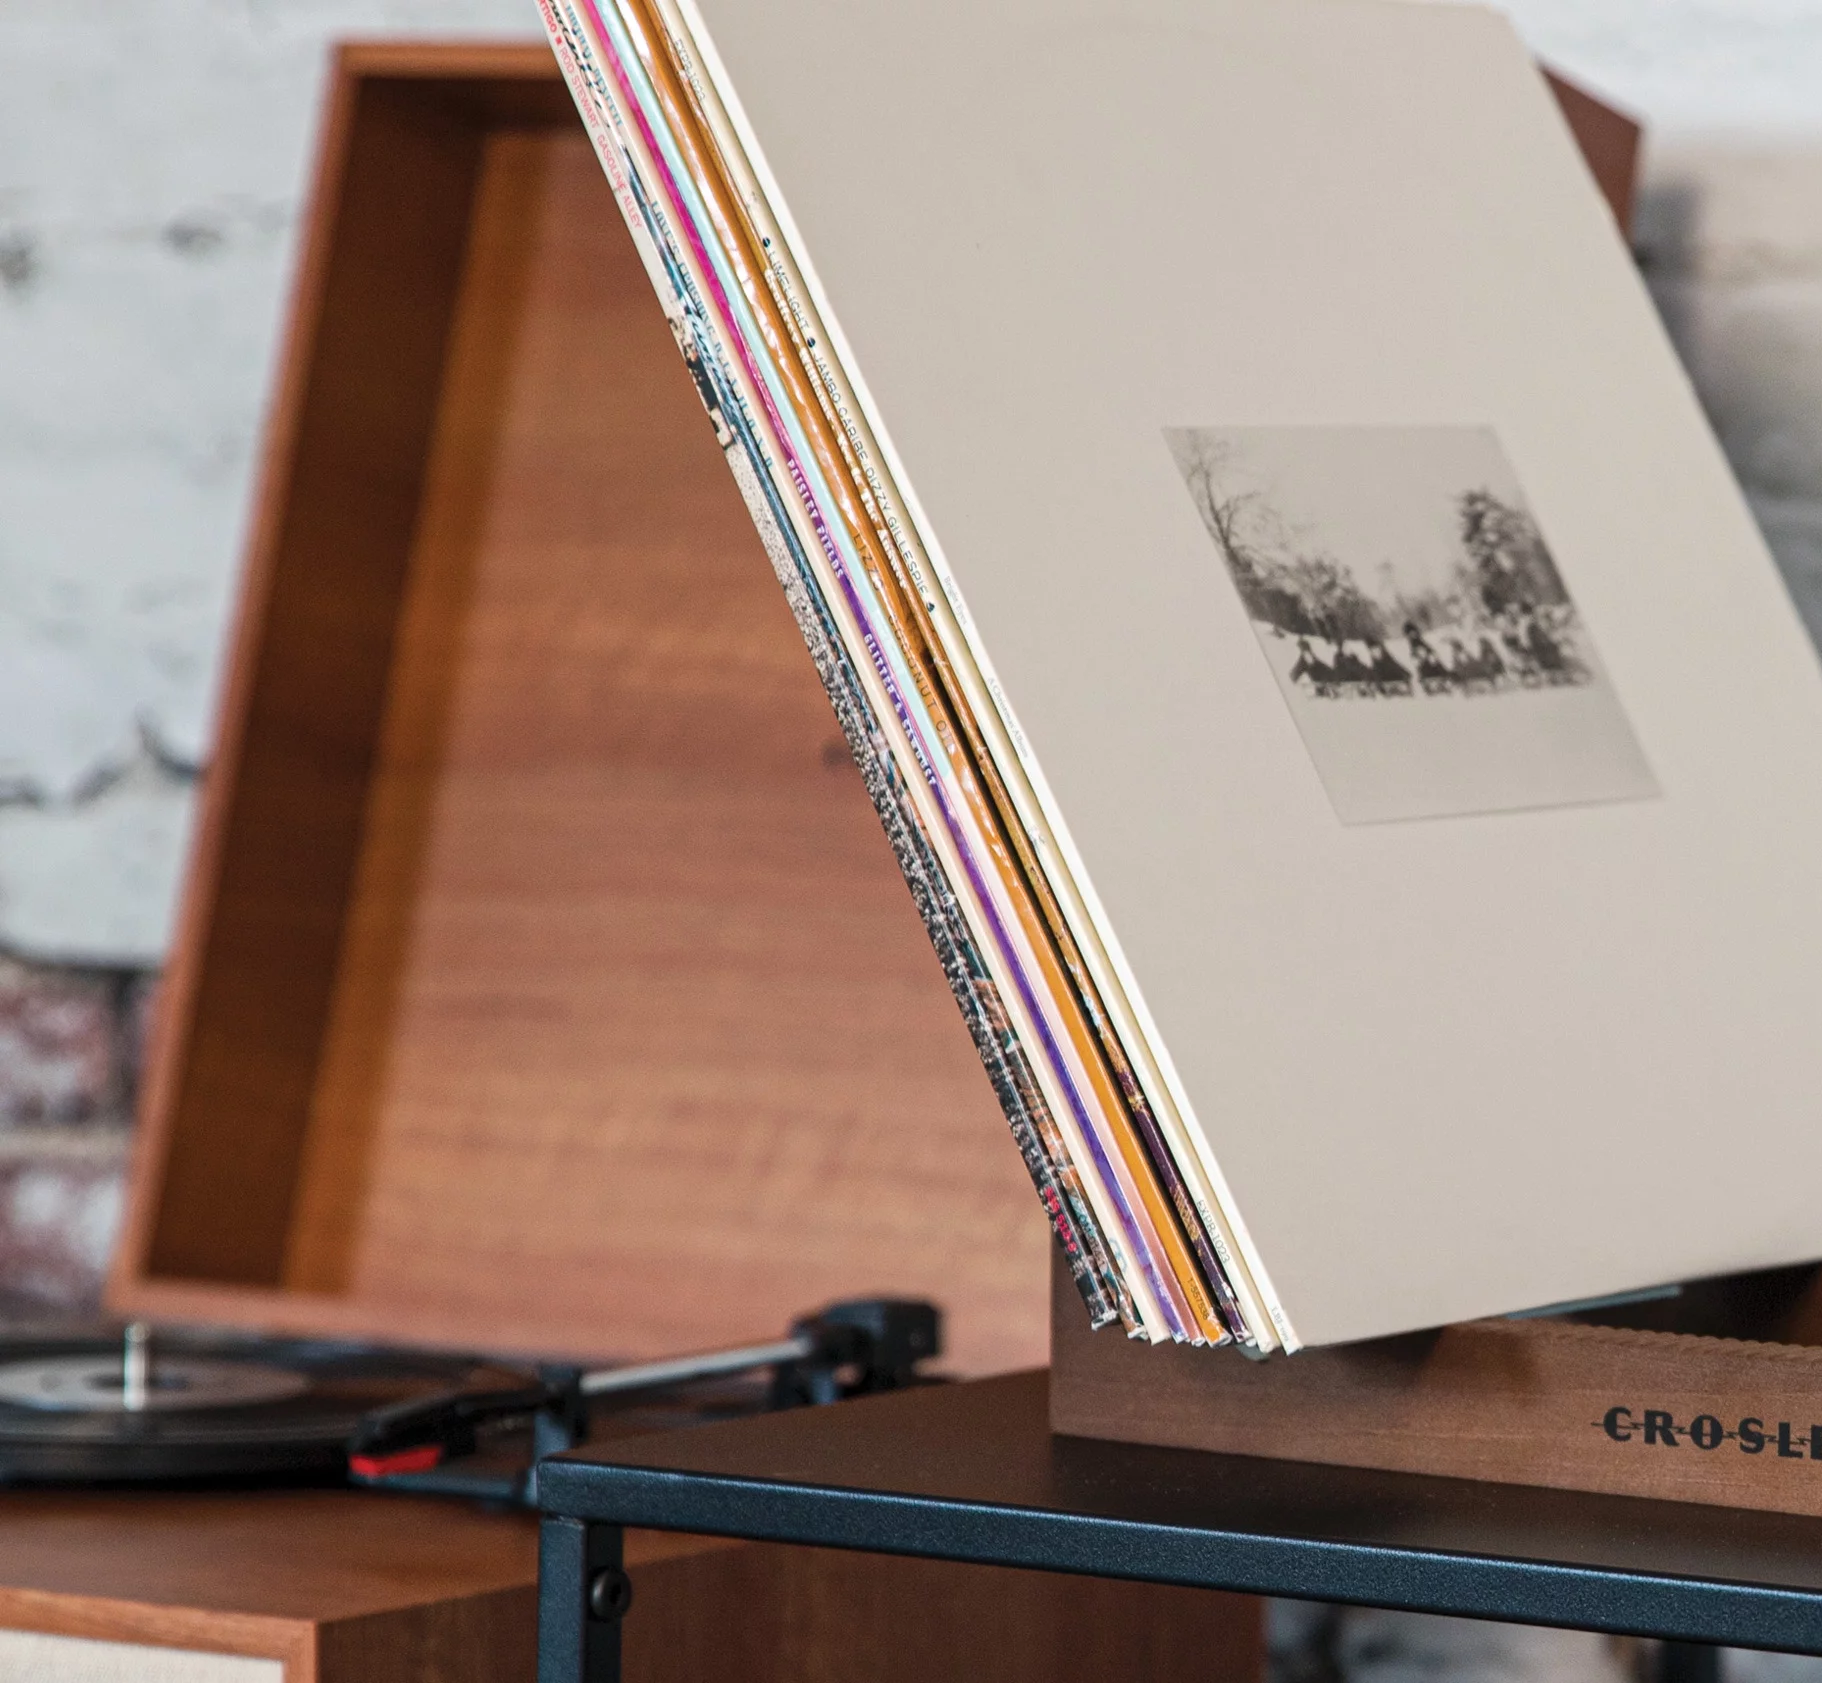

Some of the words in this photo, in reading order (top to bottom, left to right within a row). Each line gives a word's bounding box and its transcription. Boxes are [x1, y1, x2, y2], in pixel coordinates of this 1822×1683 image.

[558, 47, 574, 73] ROD
[569, 75, 599, 128] STEWART
[594, 134, 627, 192] GASOLINE
[621, 194, 643, 229] ALLEY
[784, 458, 819, 520] PAISLEY
[814, 524, 845, 578] FIELDS
[862, 632, 896, 694] GLITTER
[812, 352, 842, 404] JAMBO
[836, 406, 868, 461] CARIBE
[886, 515, 929, 595] GILLESPIE
